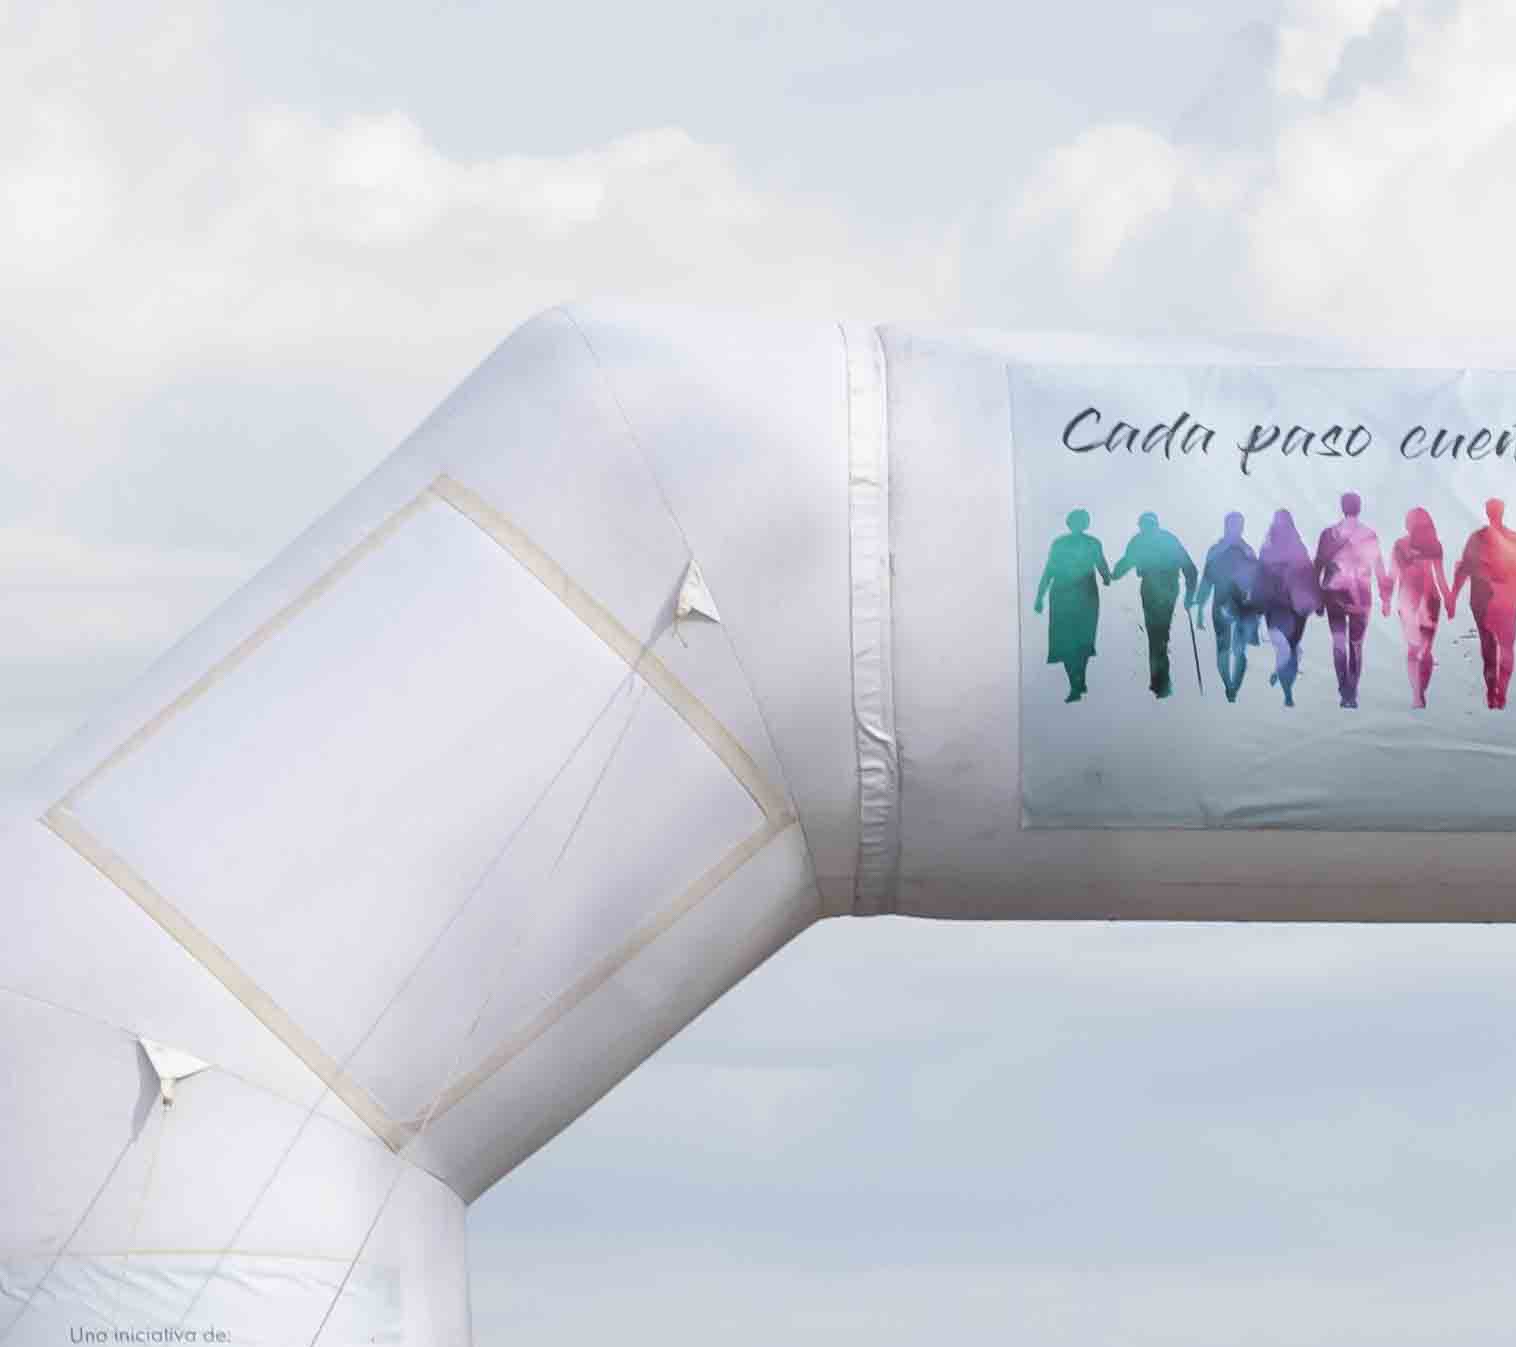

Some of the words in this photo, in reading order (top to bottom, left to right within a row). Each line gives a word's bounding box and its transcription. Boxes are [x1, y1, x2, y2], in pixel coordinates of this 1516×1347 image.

[1061, 406, 1217, 460] Cada
[1237, 422, 1373, 475] paso
[69, 1327, 108, 1345] Una
[114, 1326, 197, 1345] iniciativa
